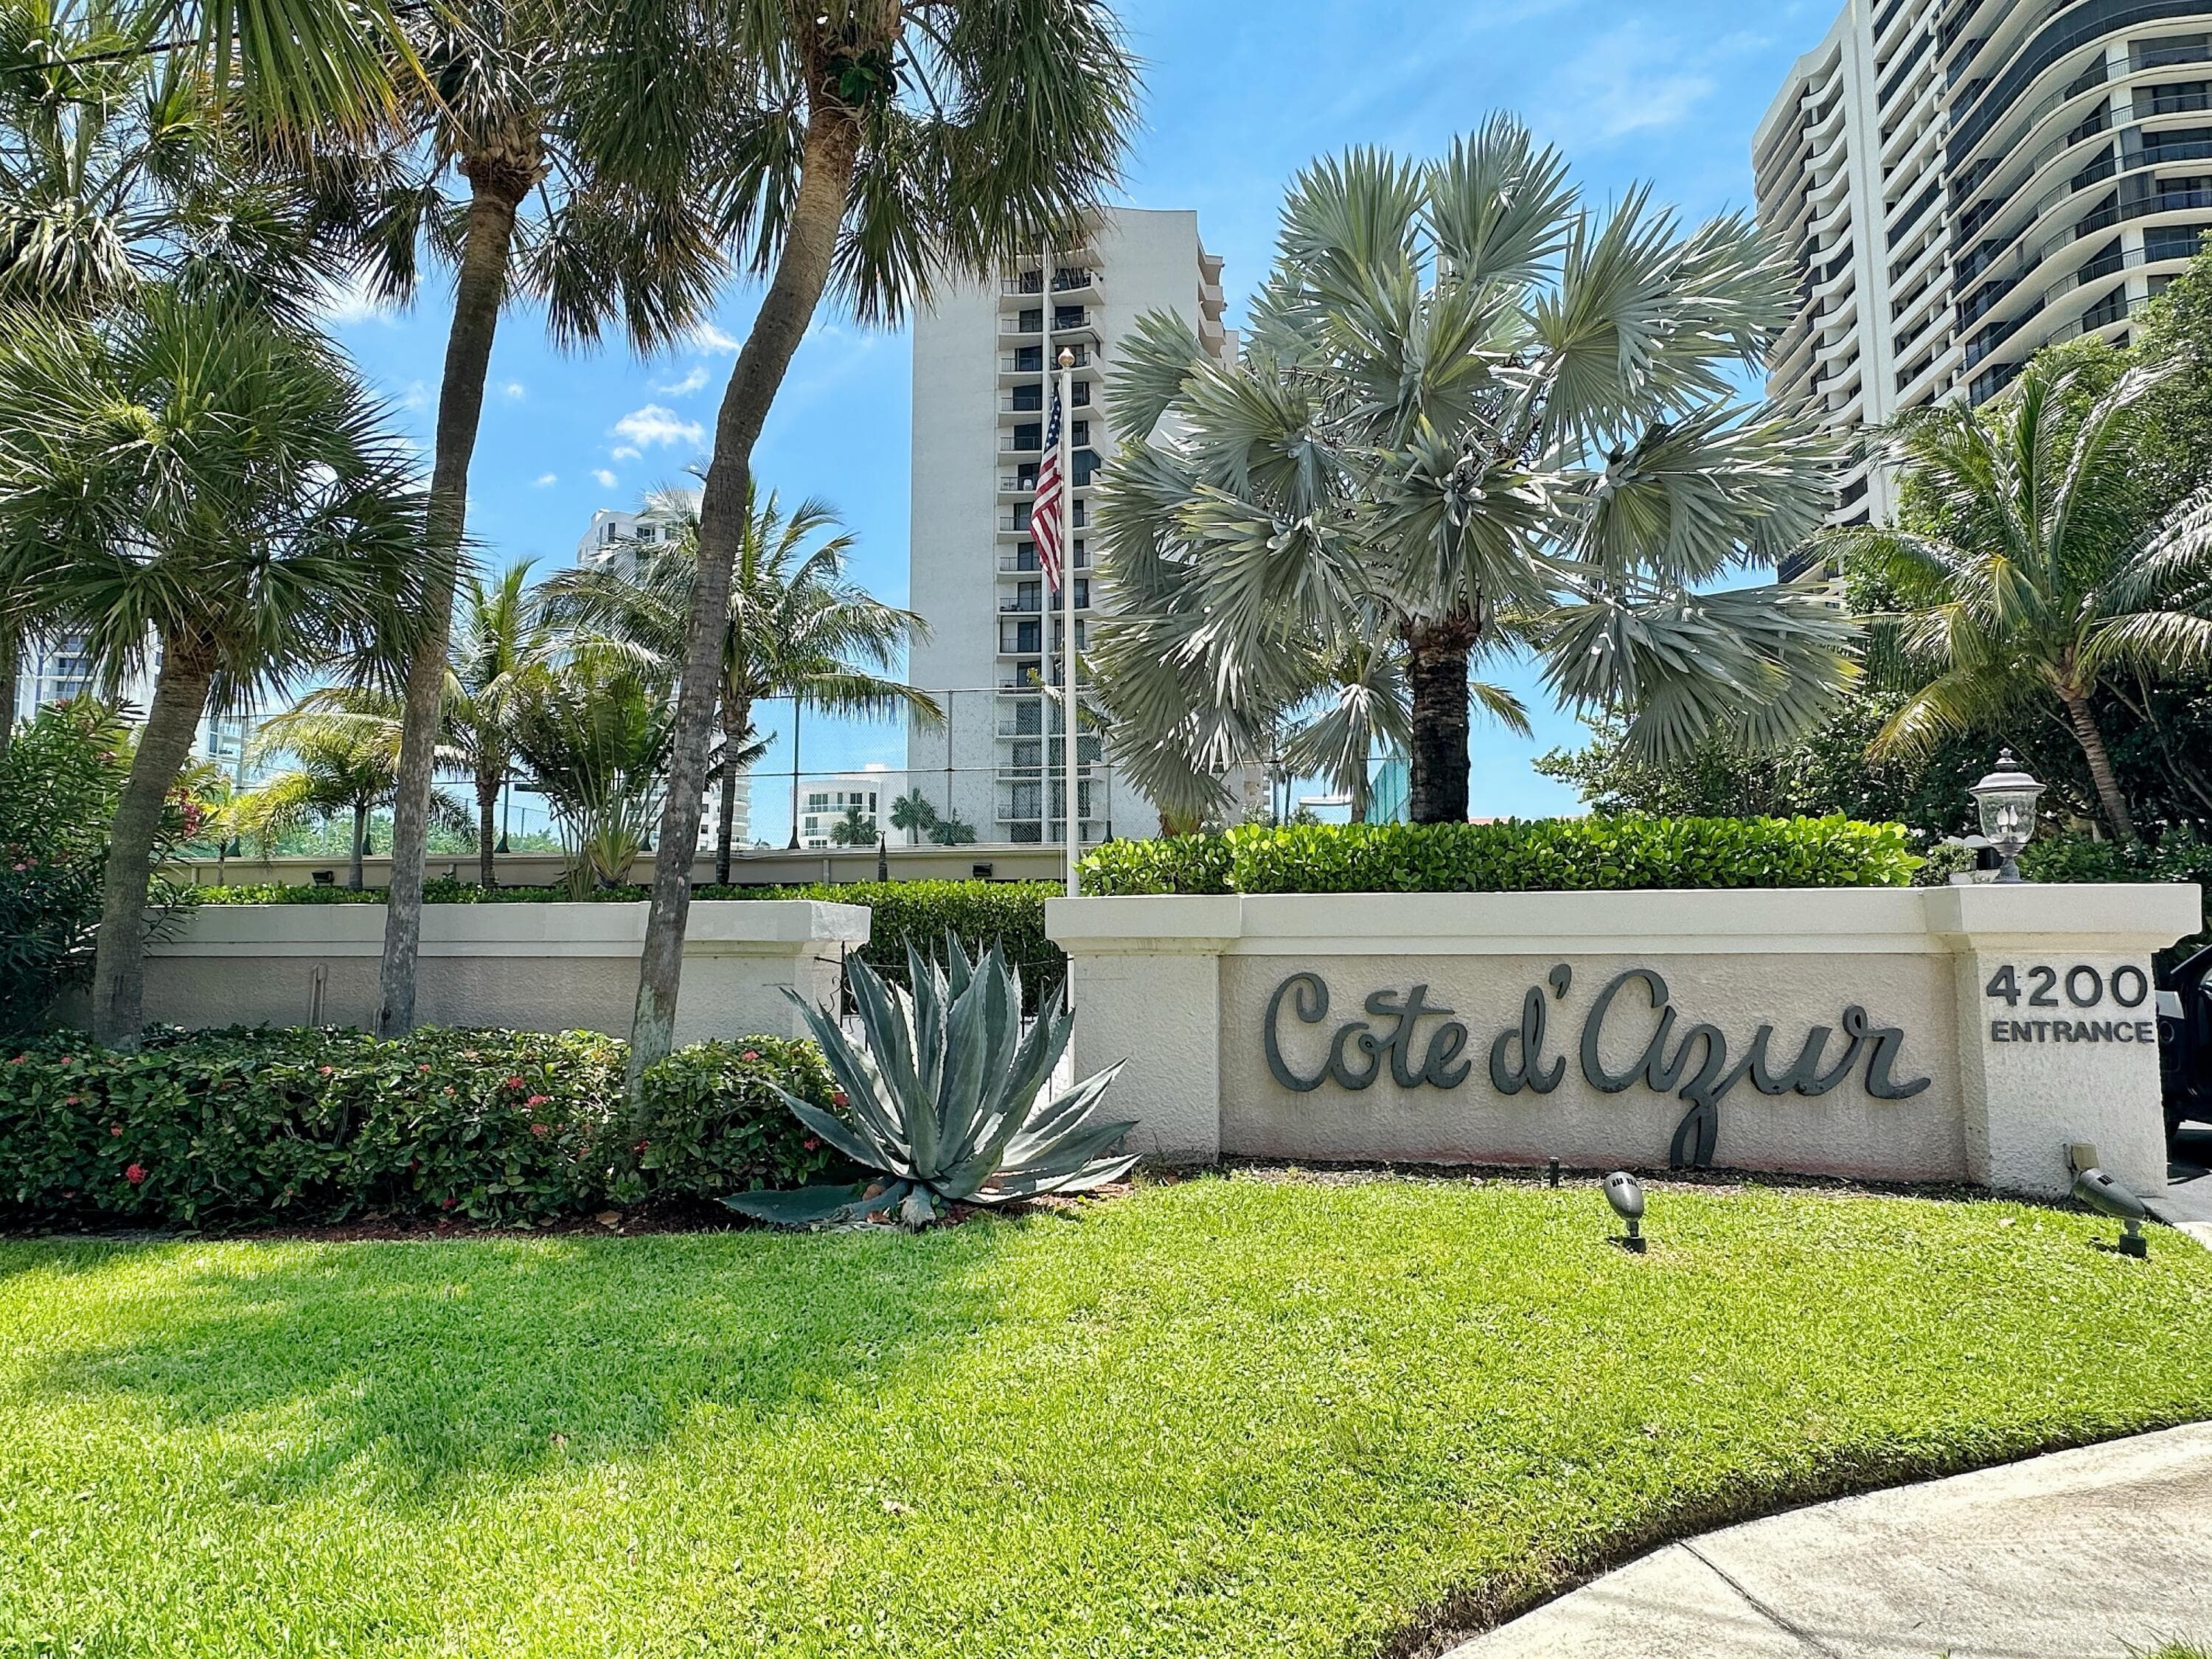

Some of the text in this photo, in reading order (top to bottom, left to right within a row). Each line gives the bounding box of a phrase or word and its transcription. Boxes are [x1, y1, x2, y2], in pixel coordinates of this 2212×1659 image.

[1986, 965, 2148, 1007] 4200
[1265, 972, 1471, 1091] Cote
[1992, 1020, 2154, 1043] ENTRANCE
